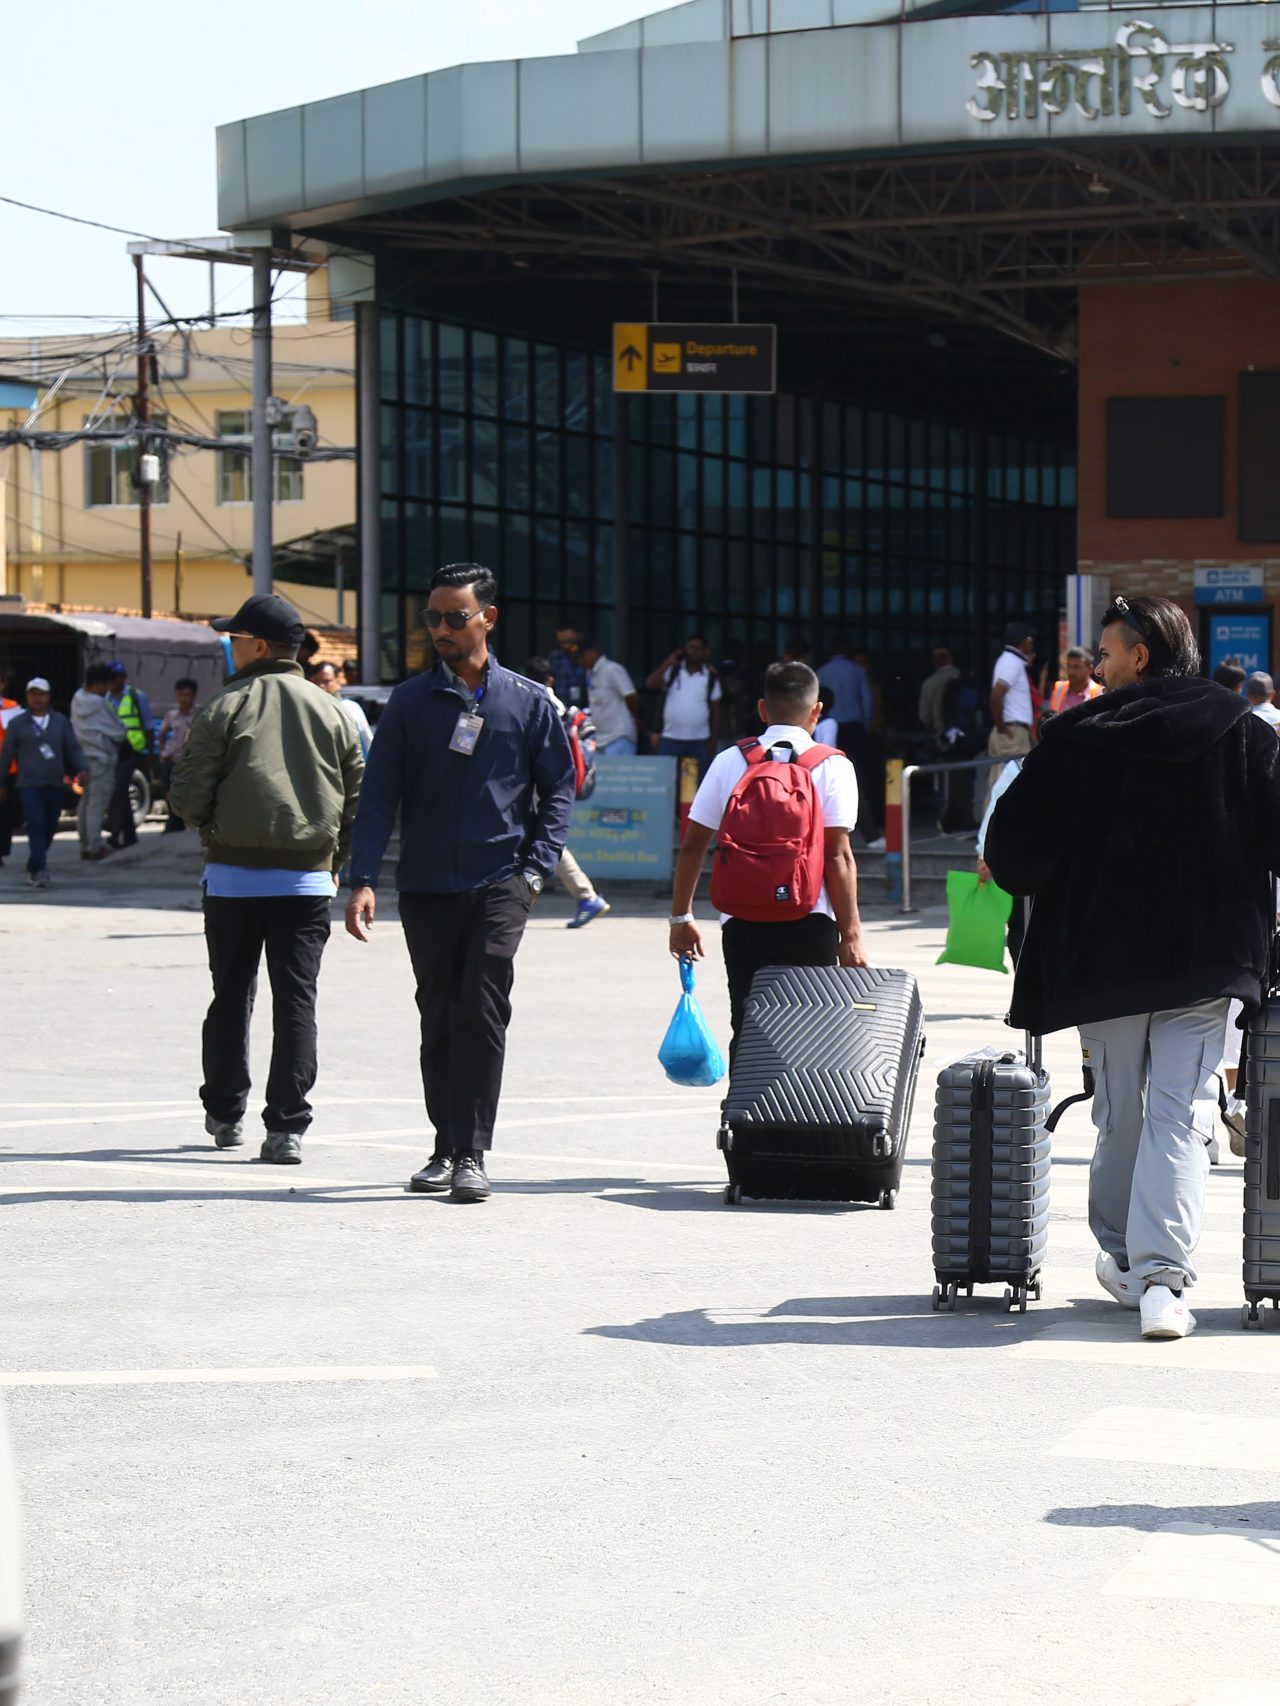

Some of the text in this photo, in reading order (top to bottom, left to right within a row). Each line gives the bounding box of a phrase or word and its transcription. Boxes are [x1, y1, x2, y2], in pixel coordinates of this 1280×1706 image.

[966, 19, 1234, 120] आन्तरिक
[687, 341, 758, 357] Departure
[1215, 589, 1244, 602] ATM
